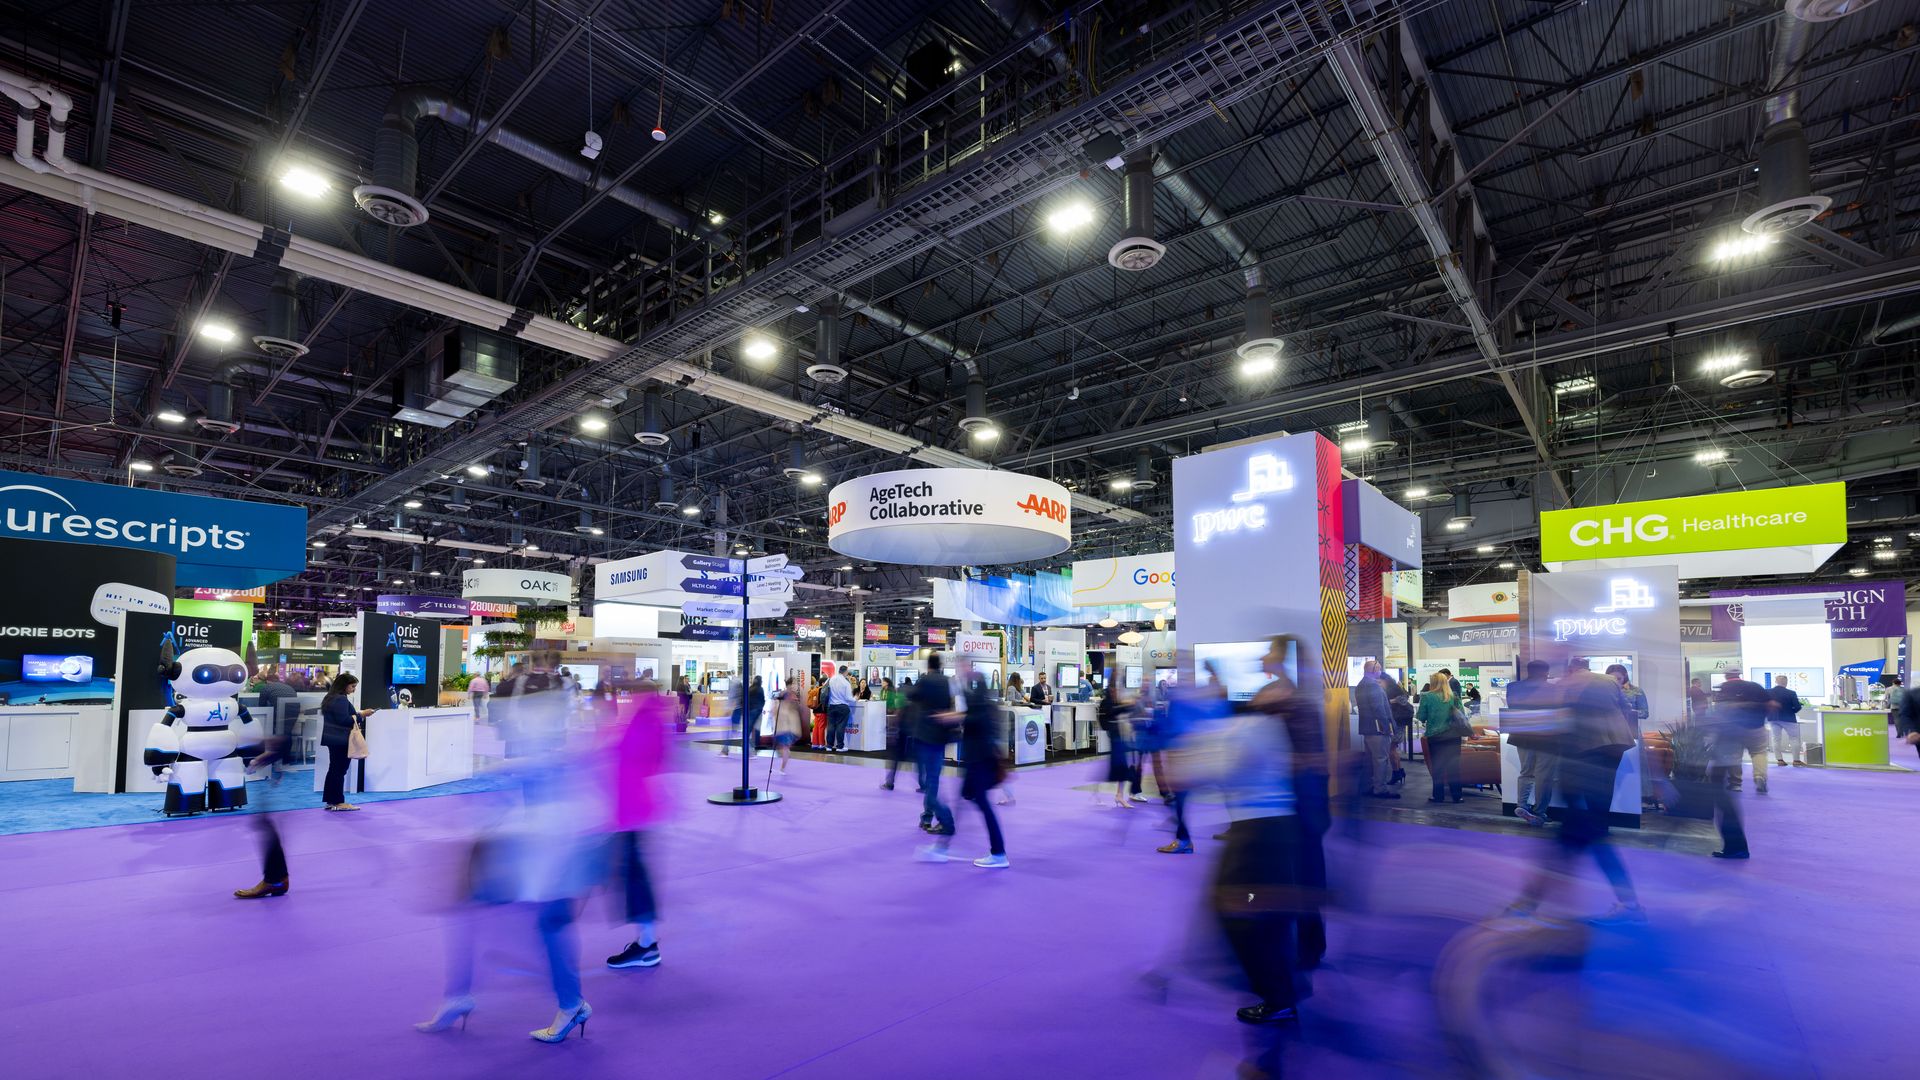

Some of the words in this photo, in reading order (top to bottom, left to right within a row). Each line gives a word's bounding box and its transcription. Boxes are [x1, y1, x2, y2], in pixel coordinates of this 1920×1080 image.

[870, 481, 933, 504] AgeTech
[870, 500, 984, 521] Collaborative
[1016, 493, 1067, 524] AARP
[0, 507, 247, 552] urescripts
[1193, 505, 1265, 543] pwc
[1569, 514, 1669, 547] CHG
[1682, 511, 1808, 534] Healthcare
[692, 559, 712, 568] Gallery
[711, 561, 726, 569] Stage
[610, 567, 648, 586] SAMSUNG
[520, 579, 551, 592] OAK
[1825, 589, 1885, 605] SIGN
[470, 600, 517, 614] 2800/3000
[680, 613, 708, 626] NICE
[0, 627, 48, 638] JORIE
[52, 628, 96, 638] BOTS
[1554, 617, 1626, 641] pwc
[1150, 650, 1177, 660] Goog
[1843, 727, 1873, 737] CHG
